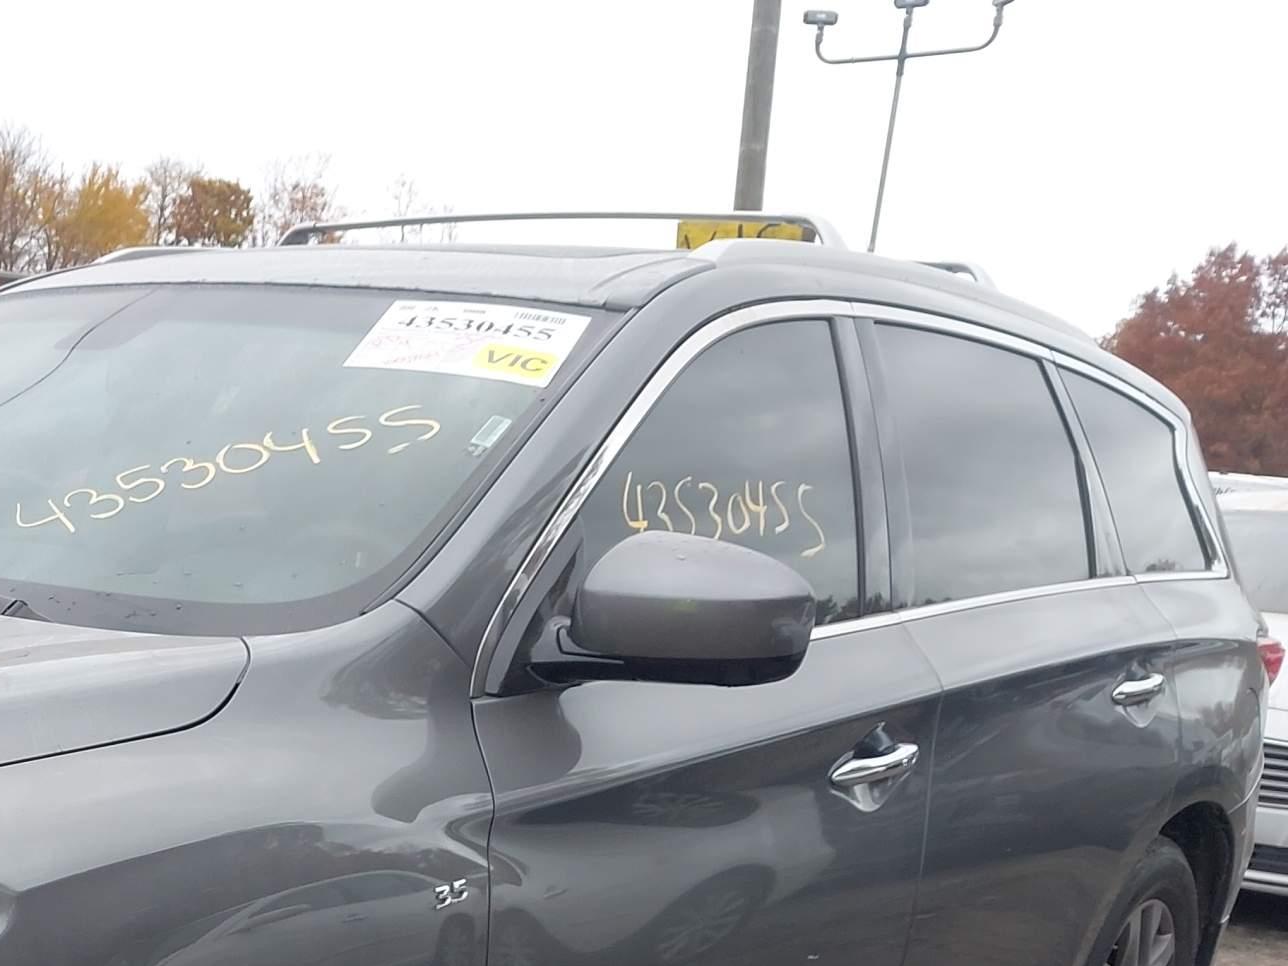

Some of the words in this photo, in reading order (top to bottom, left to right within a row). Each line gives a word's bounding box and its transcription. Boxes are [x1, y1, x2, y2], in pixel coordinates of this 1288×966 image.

[398, 315, 556, 341] 43530455
[487, 350, 548, 372] VIC
[15, 404, 442, 534] 43530455
[622, 471, 826, 557] 43530455
